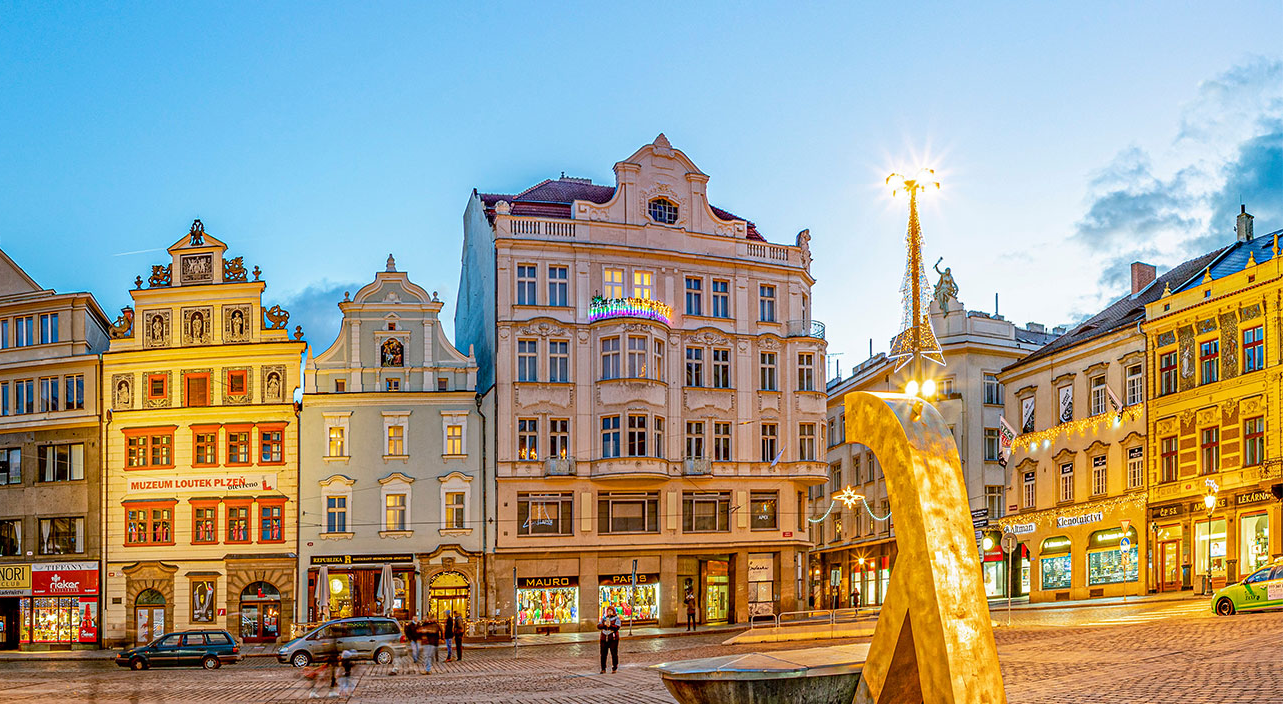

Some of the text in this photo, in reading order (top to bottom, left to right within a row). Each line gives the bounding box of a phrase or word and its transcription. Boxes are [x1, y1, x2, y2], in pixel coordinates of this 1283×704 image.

[130, 476, 246, 490] MUZEUM LOUTEK PLZEŇ
[49, 580, 80, 589] rieker
[526, 577, 569, 586] MAURO
